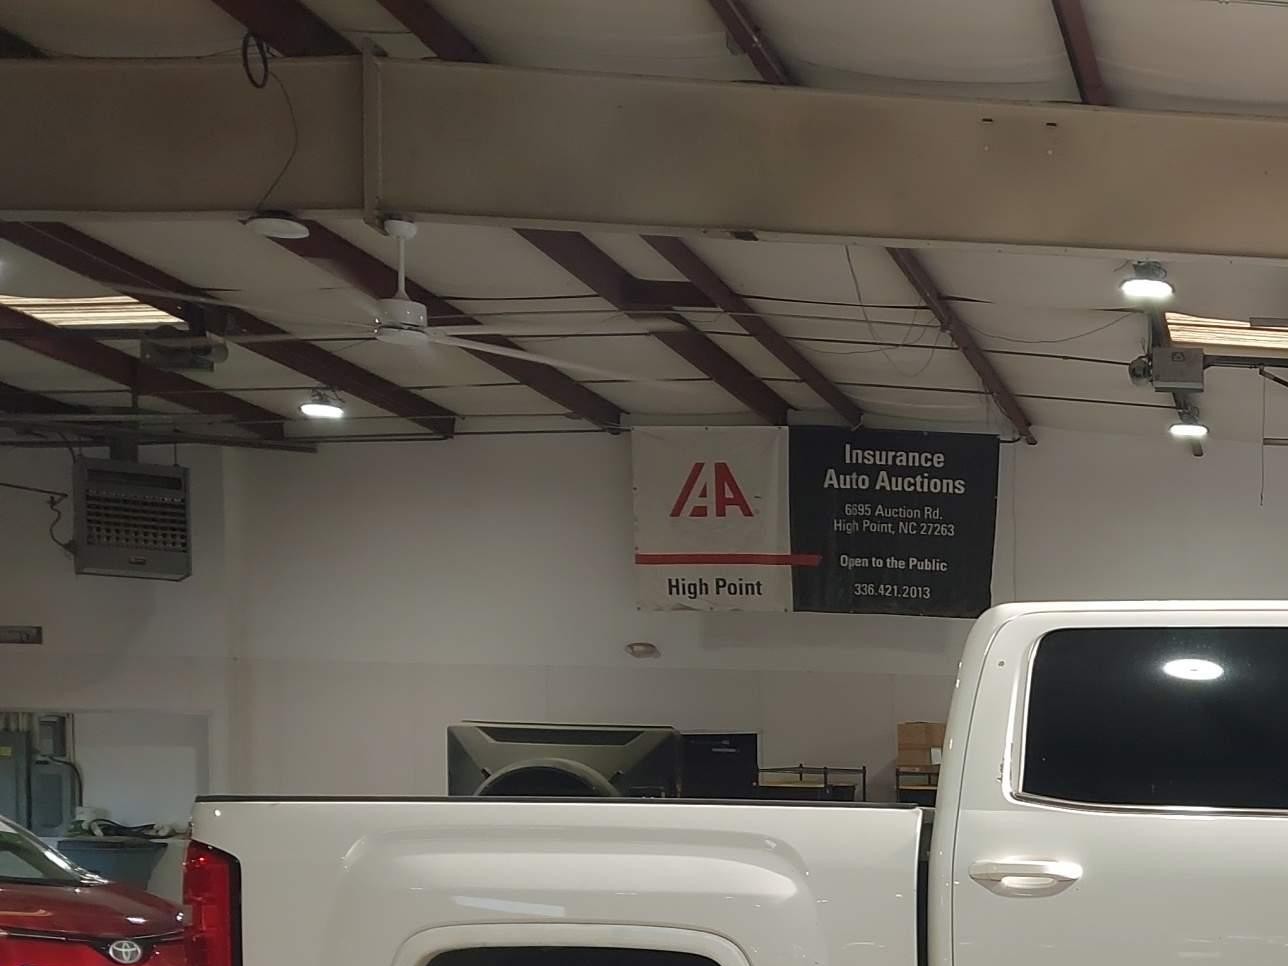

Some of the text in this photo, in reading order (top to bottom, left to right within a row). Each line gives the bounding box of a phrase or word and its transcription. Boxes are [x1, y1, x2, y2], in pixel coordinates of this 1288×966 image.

[844, 443, 945, 468] Insurance
[823, 469, 966, 495] Auto Auctions
[875, 504, 920, 519] Auction
[924, 507, 943, 520] Rd.
[833, 519, 955, 537] High Point, NC 27263
[839, 555, 948, 572] Open to the Public
[667, 578, 763, 598] High Point
[854, 583, 931, 600] 336.421.2013
